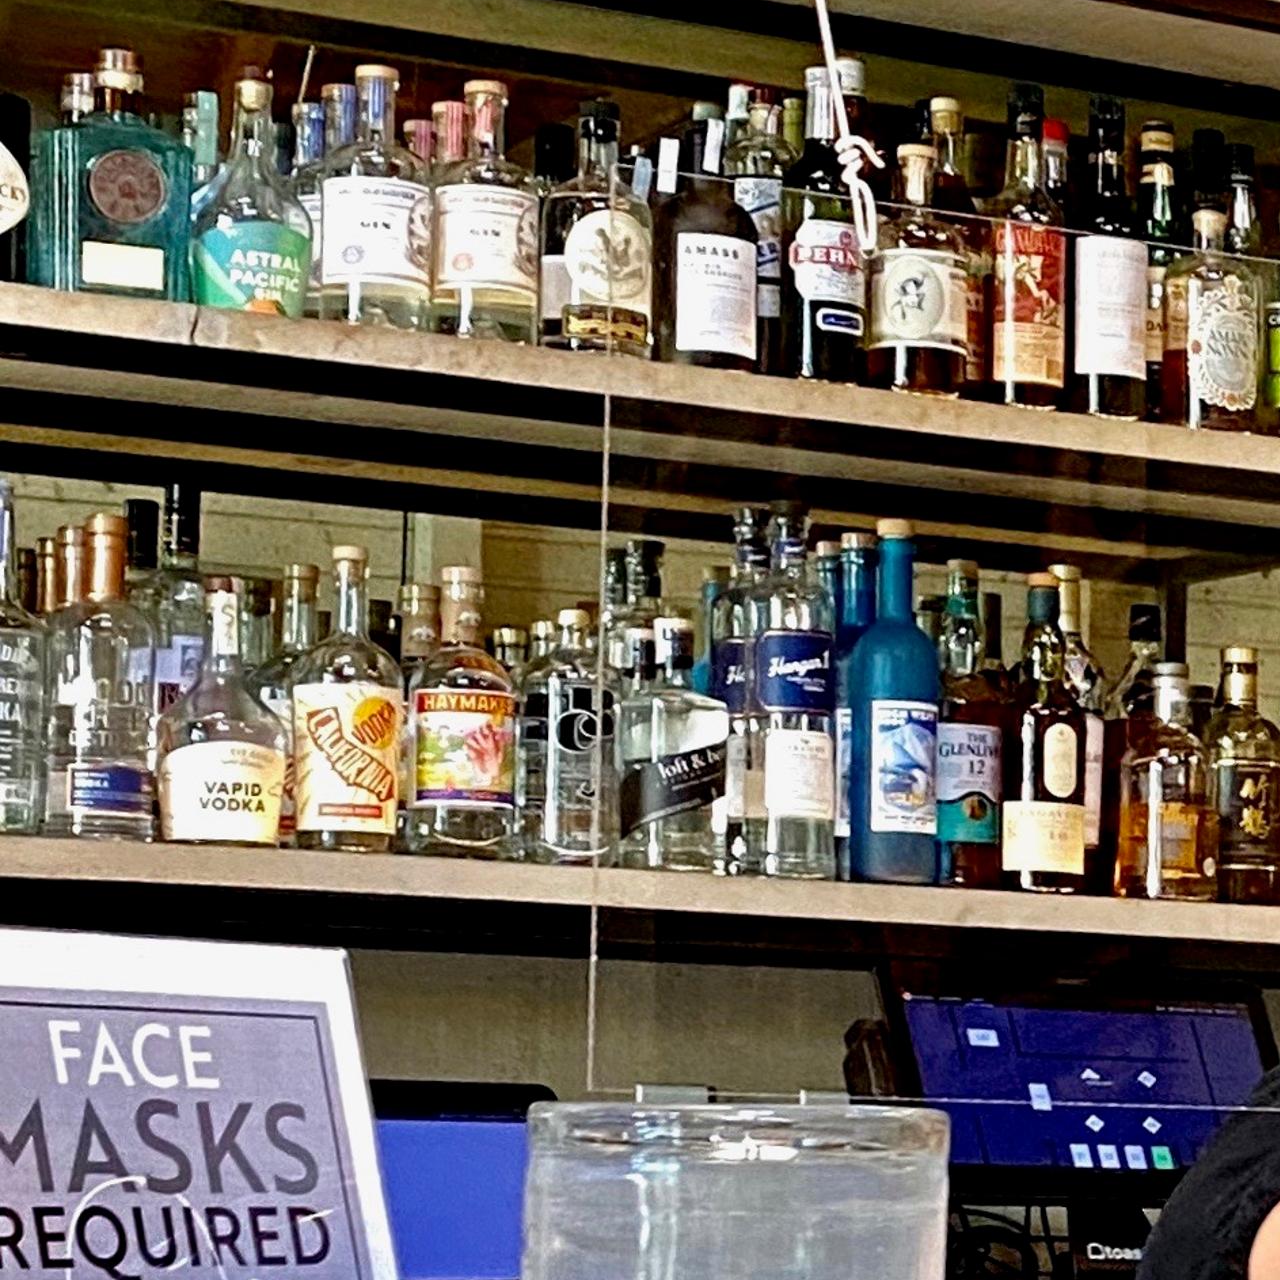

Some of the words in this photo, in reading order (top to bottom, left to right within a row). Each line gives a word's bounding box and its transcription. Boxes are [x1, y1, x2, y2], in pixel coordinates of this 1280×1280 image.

[230, 250, 302, 272] ASTRAL
[229, 269, 301, 293] PACIFIC
[351, 701, 397, 746] VODKA
[967, 732, 989, 743] THE
[308, 710, 394, 800] CALIFORNIA
[968, 759, 986, 775] 12
[204, 780, 263, 797] VAPID
[199, 796, 267, 814] VODKA
[48, 1020, 221, 1089] FACE
[0, 1096, 320, 1196] MASKS
